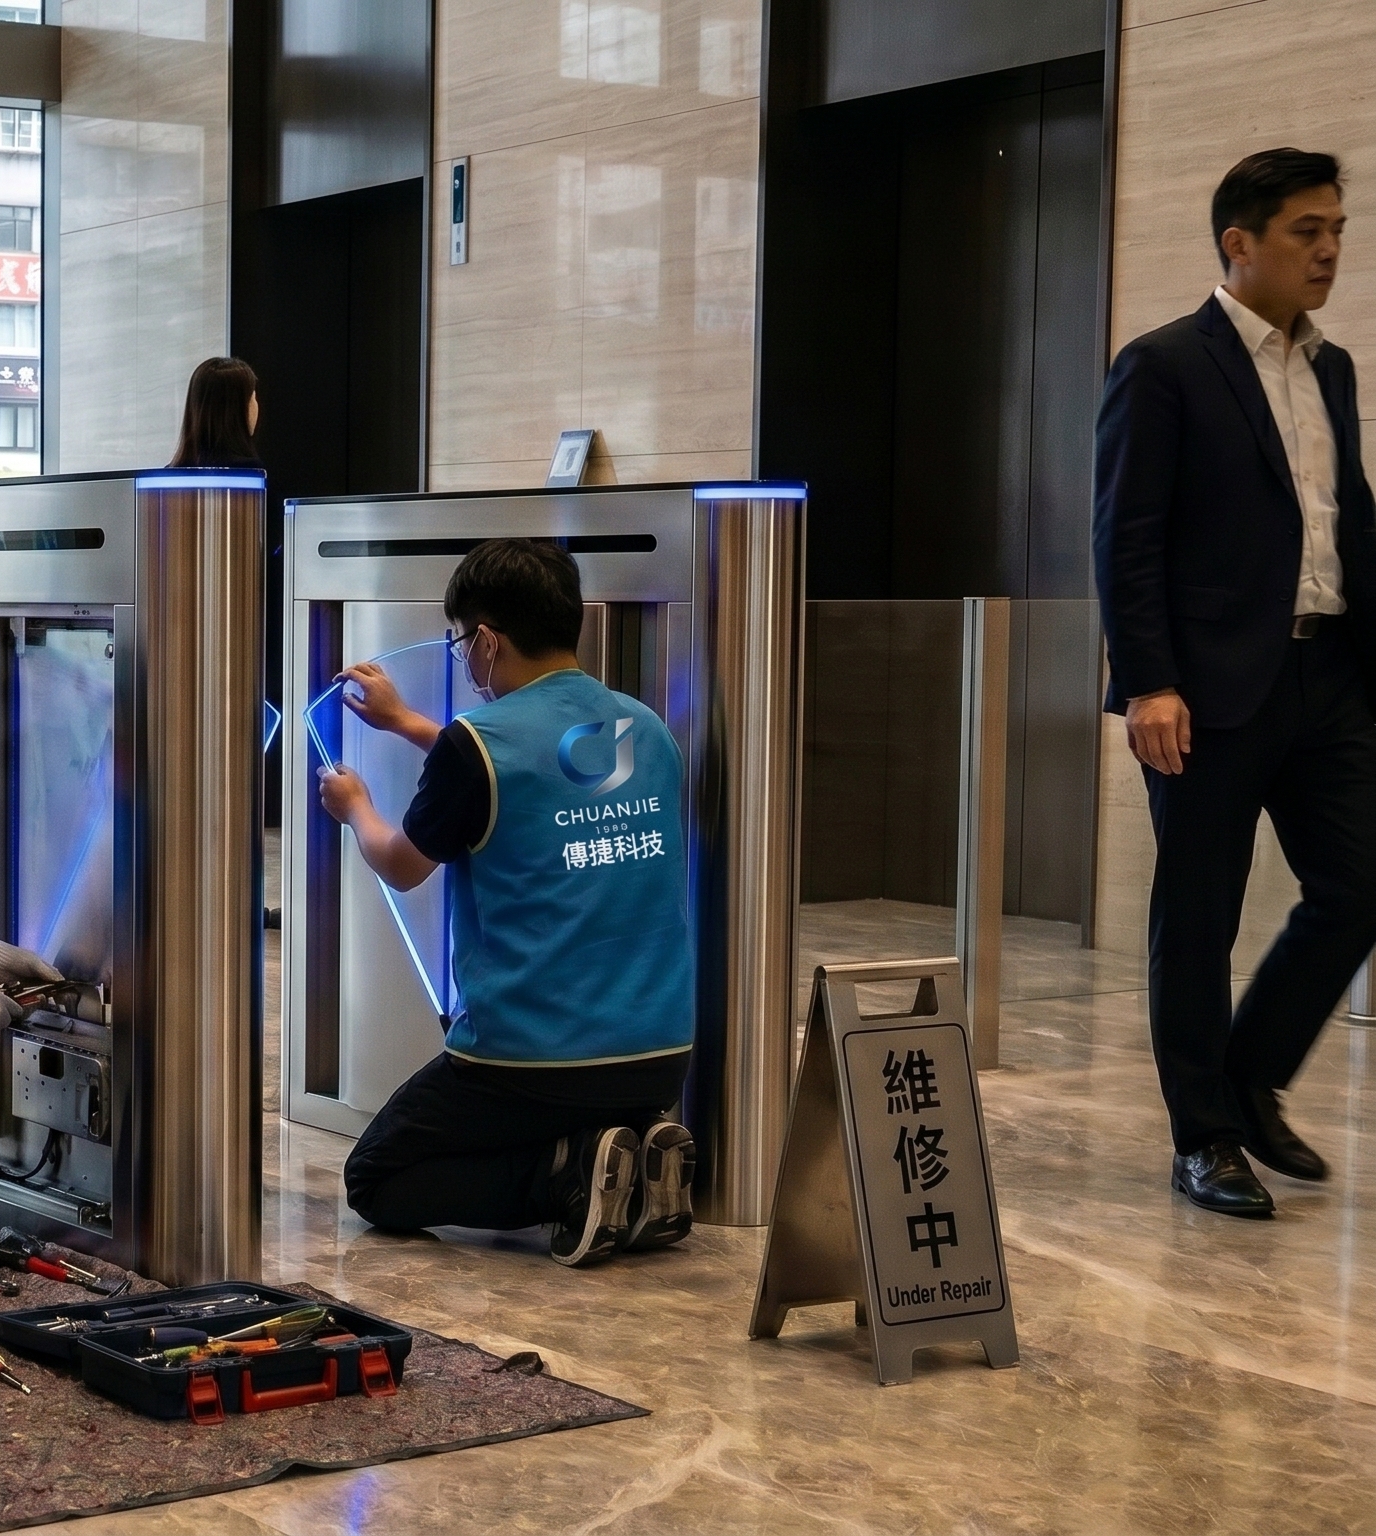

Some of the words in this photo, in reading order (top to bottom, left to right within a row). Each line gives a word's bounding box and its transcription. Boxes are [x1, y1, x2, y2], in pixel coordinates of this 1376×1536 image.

[554, 796, 661, 827] CHUANJIE
[562, 829, 666, 871] 傳捷科技
[881, 1048, 959, 1270] 維修中
[886, 1283, 937, 1308] Under
[939, 1275, 992, 1304] Repair
